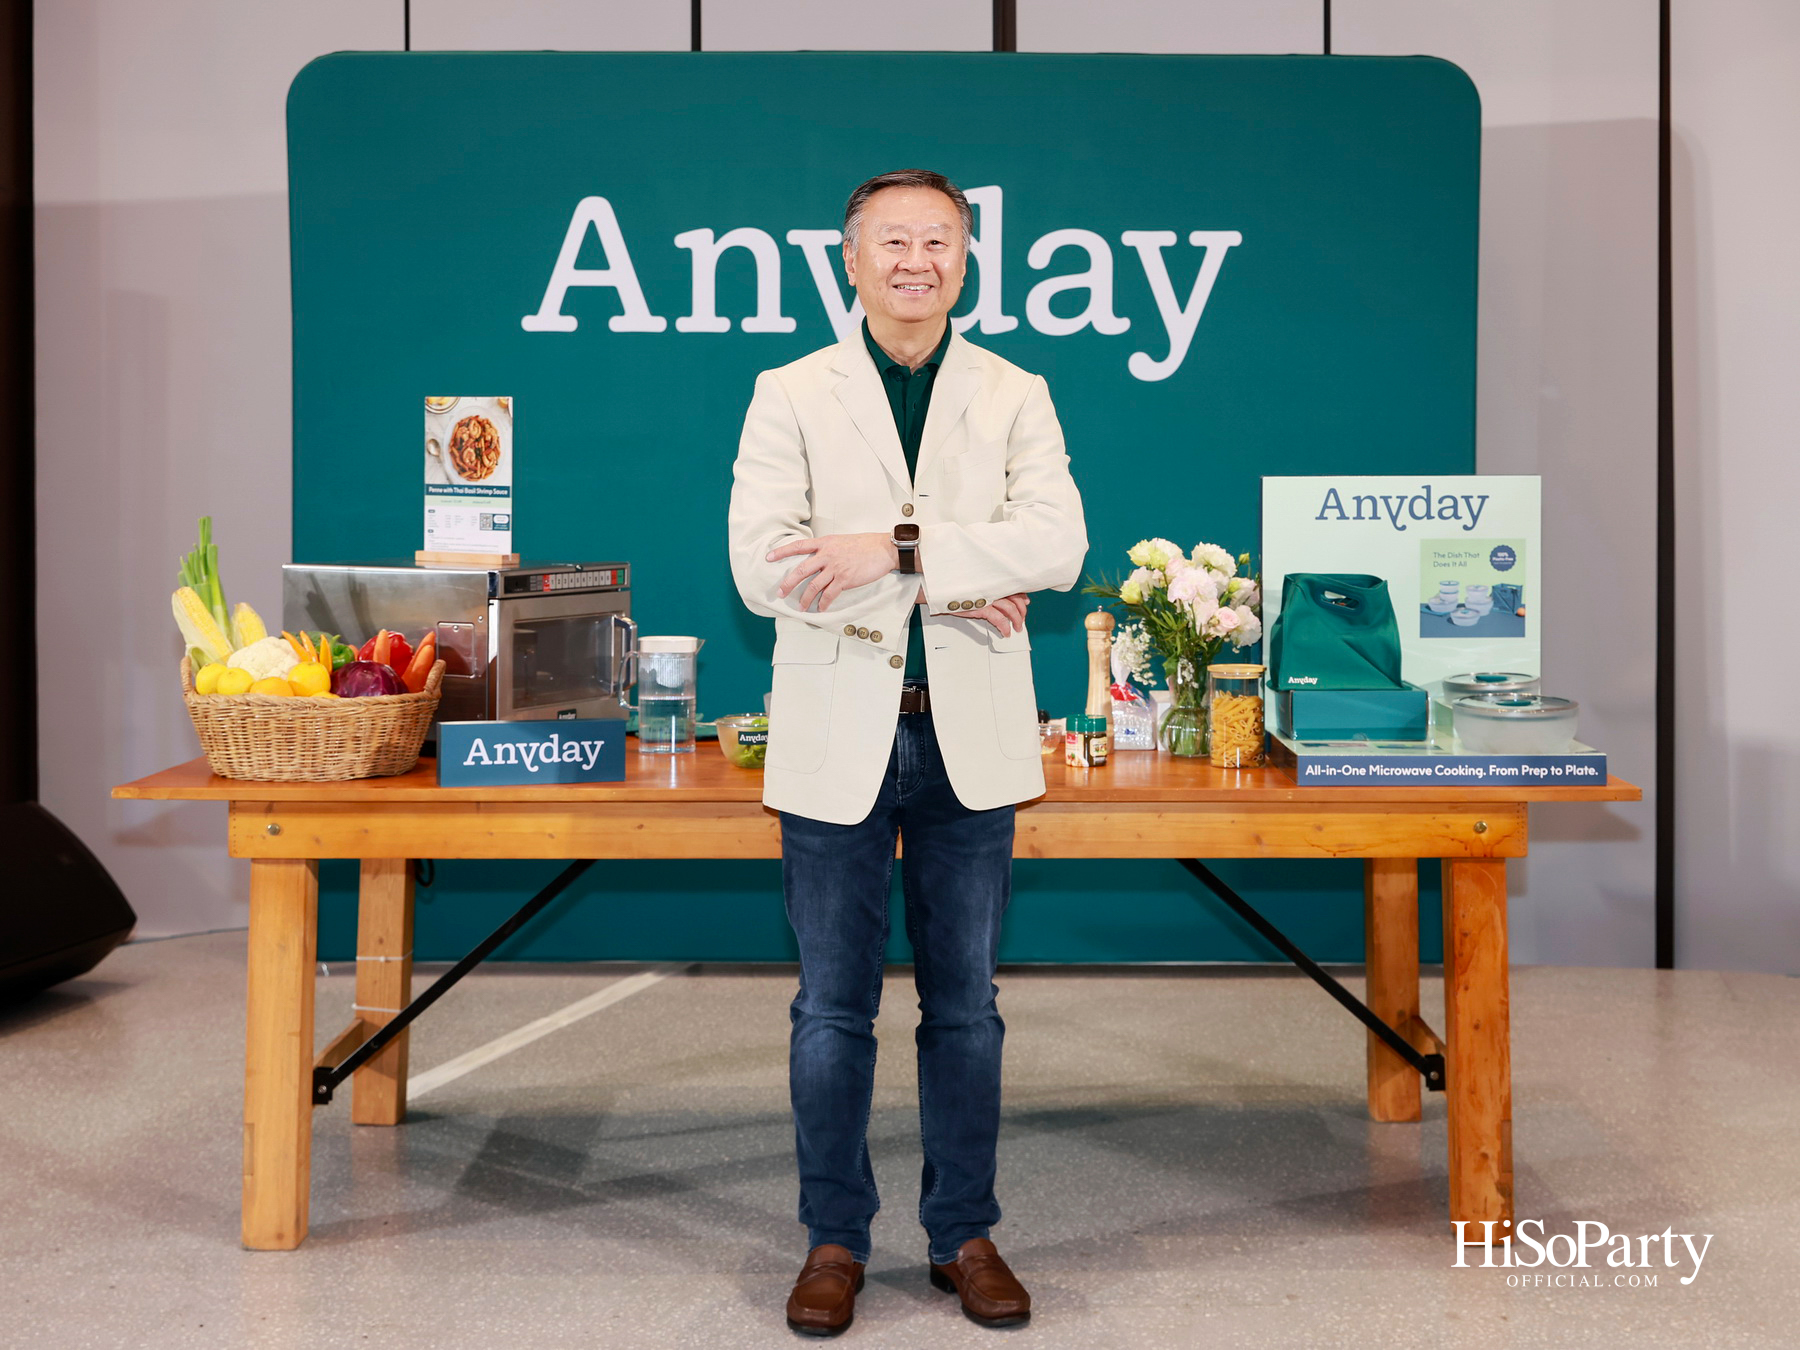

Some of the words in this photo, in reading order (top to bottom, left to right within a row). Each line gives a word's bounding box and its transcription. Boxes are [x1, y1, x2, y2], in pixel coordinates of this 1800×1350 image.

[453, 486, 464, 494] Thai
[476, 487, 493, 496] Shrimp
[1315, 485, 1490, 531] Anyday
[1288, 676, 1318, 685] Anyday
[463, 733, 605, 772] Anyday
[1305, 764, 1366, 776] All-in-One
[1369, 764, 1432, 776] Microwave
[1435, 764, 1486, 779] Cooking.
[1489, 765, 1519, 776] From
[1521, 765, 1548, 778] Prep
[1550, 765, 1563, 776] to
[1565, 765, 1598, 776] Plate.
